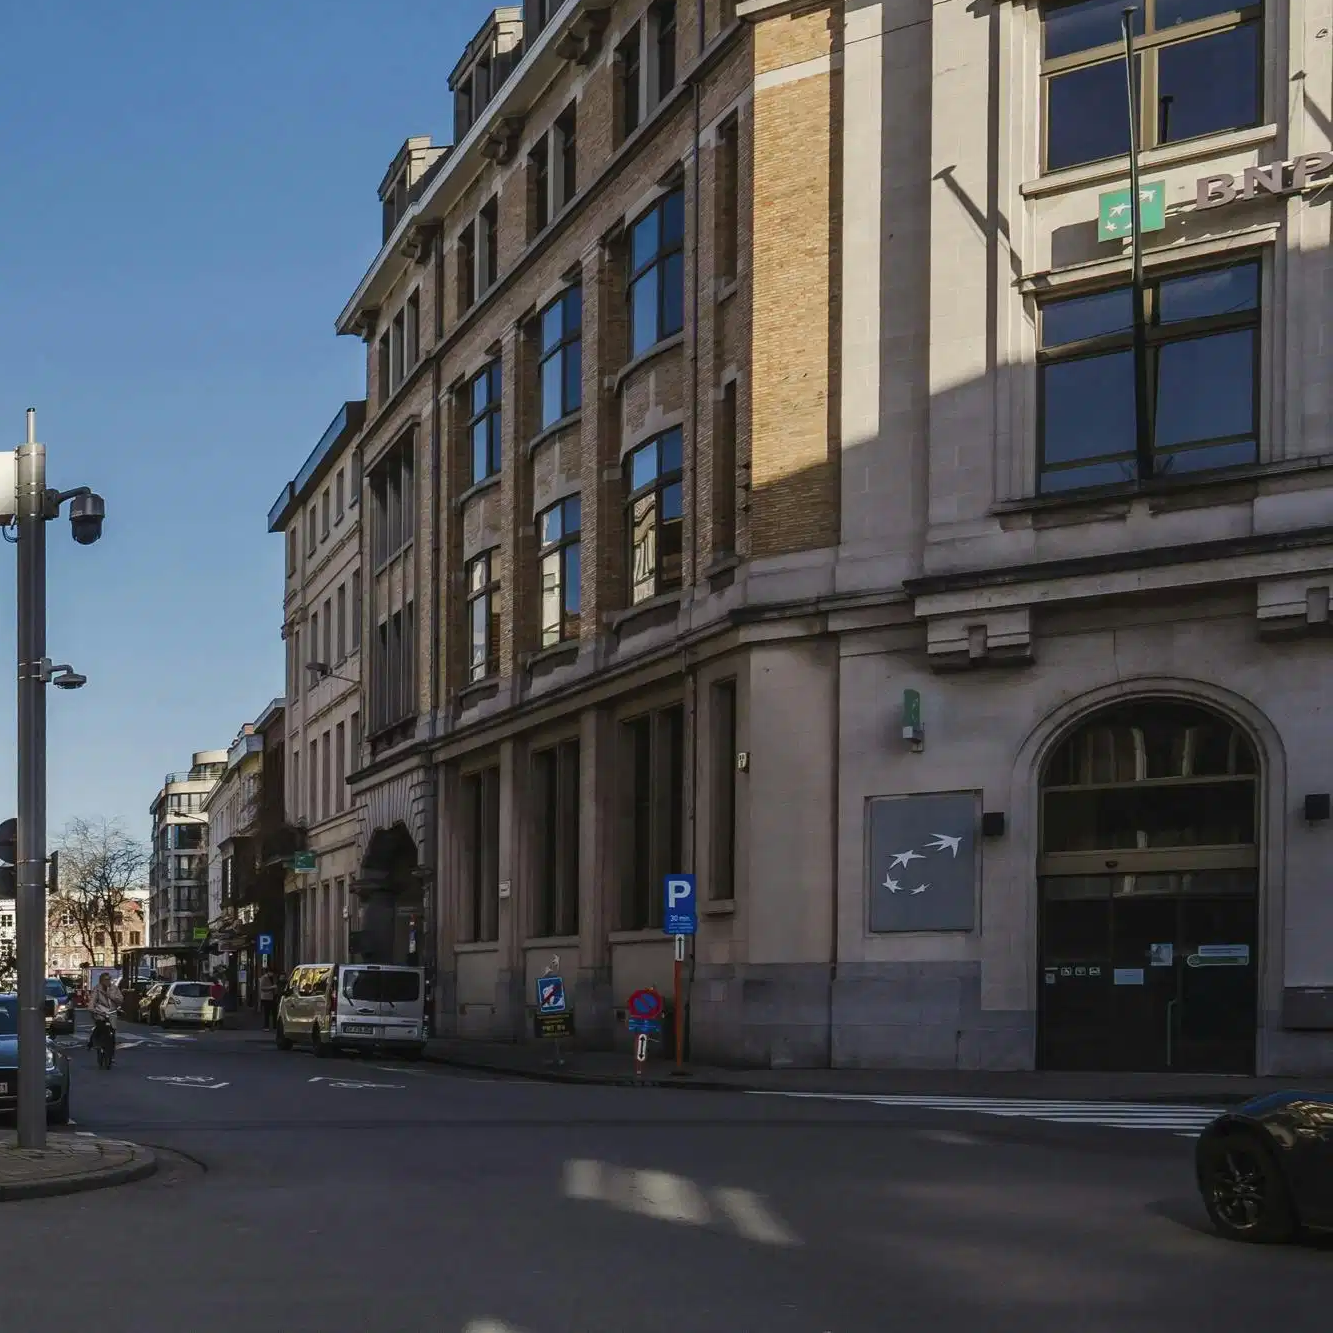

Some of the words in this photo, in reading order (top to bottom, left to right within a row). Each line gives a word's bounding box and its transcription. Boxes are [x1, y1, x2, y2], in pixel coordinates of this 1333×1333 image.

[1195, 152, 1333, 211] BNP
[668, 880, 691, 908] P
[670, 914, 678, 922] 30
[259, 935, 271, 950] P
